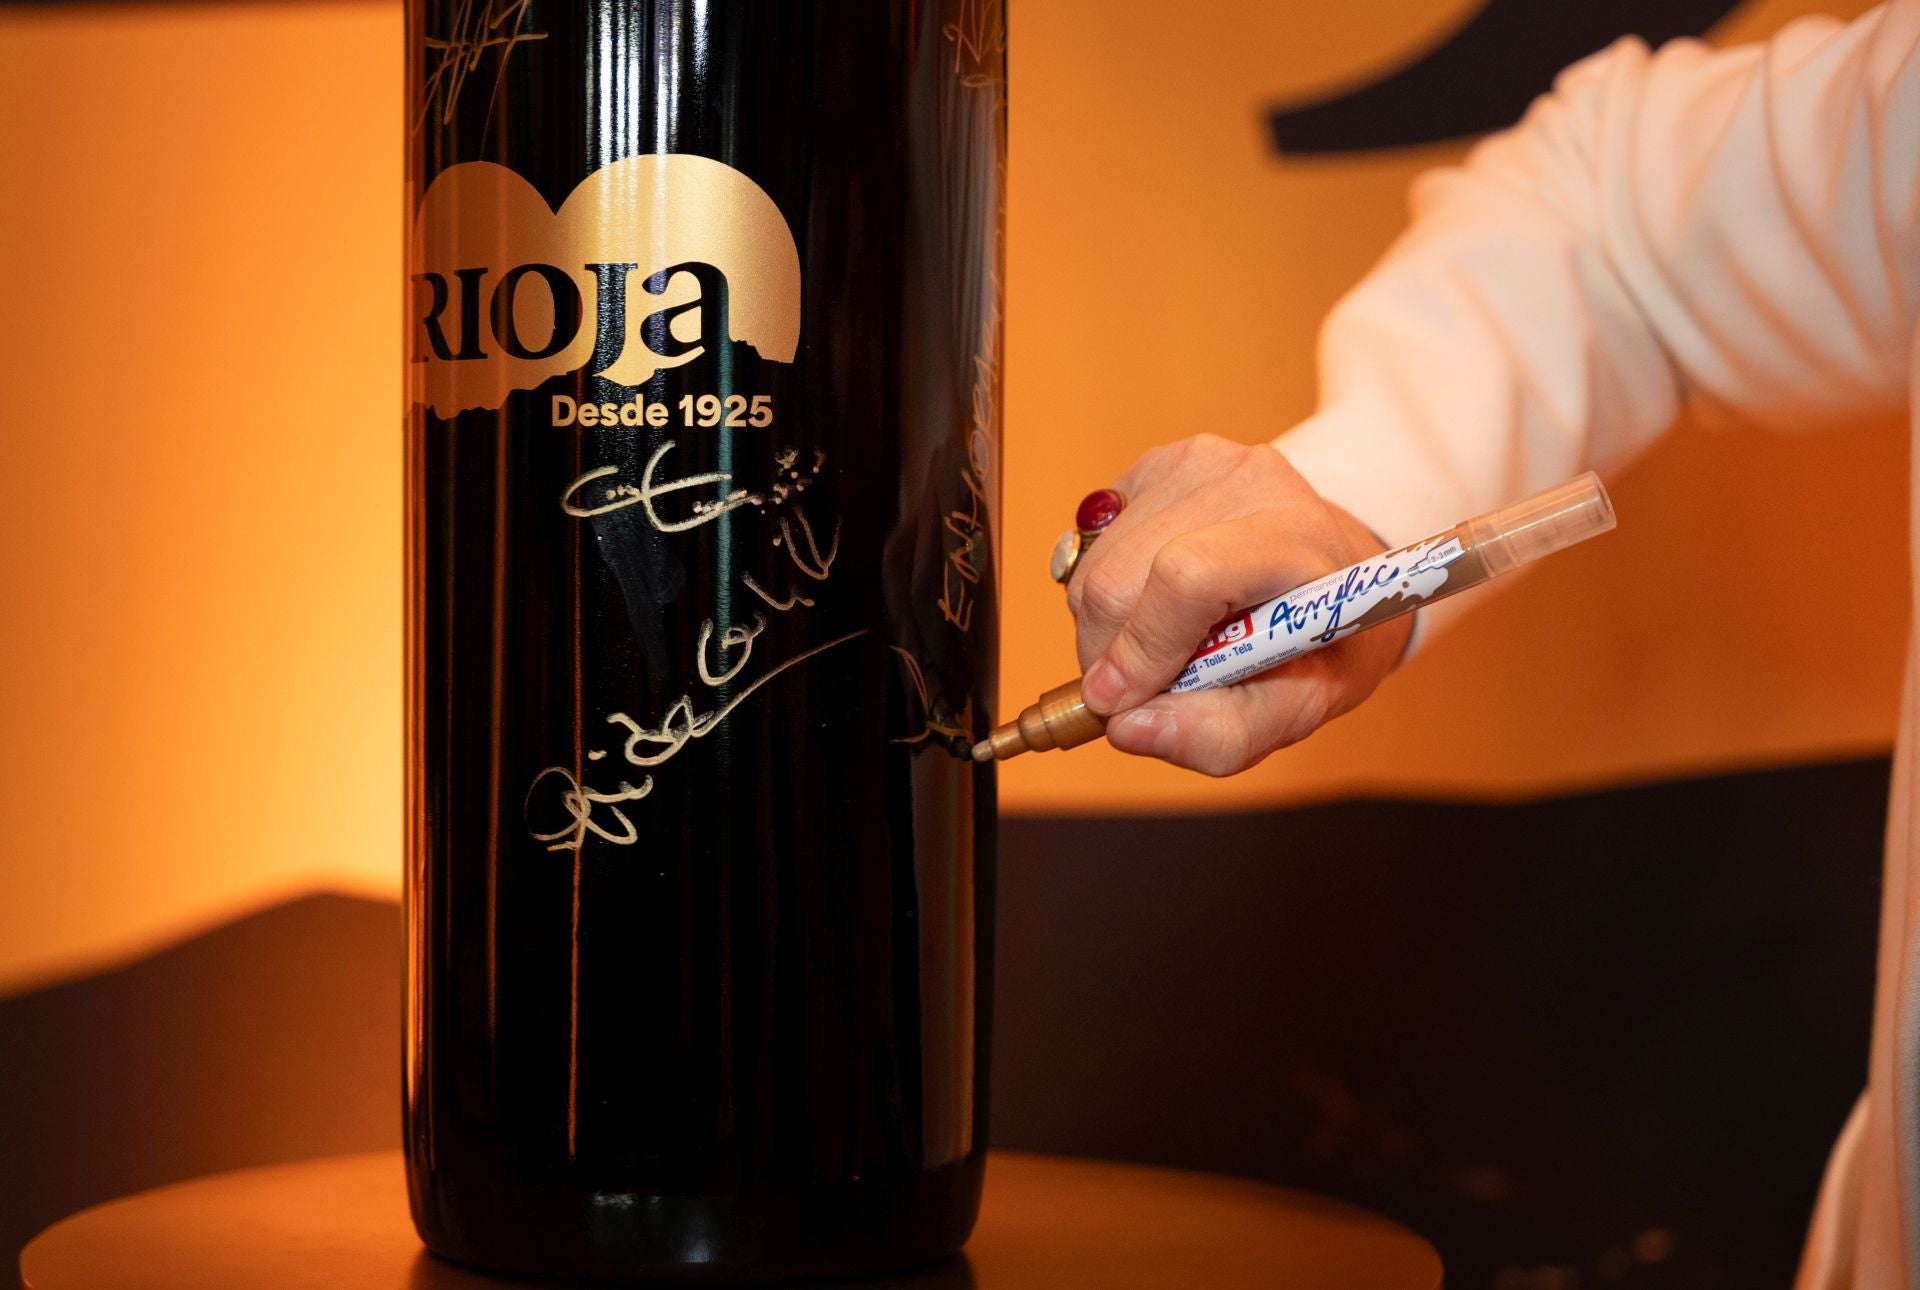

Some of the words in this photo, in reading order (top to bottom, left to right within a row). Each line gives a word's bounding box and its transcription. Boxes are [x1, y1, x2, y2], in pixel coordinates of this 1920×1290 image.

[552, 394, 669, 427] Desde
[679, 394, 773, 428] 1925
[1289, 574, 1344, 602] permanent
[1269, 564, 1399, 643] Acrylic
[1203, 653, 1227, 668] Toile
[1233, 642, 1253, 656] Tela
[1177, 675, 1200, 689] Papel
